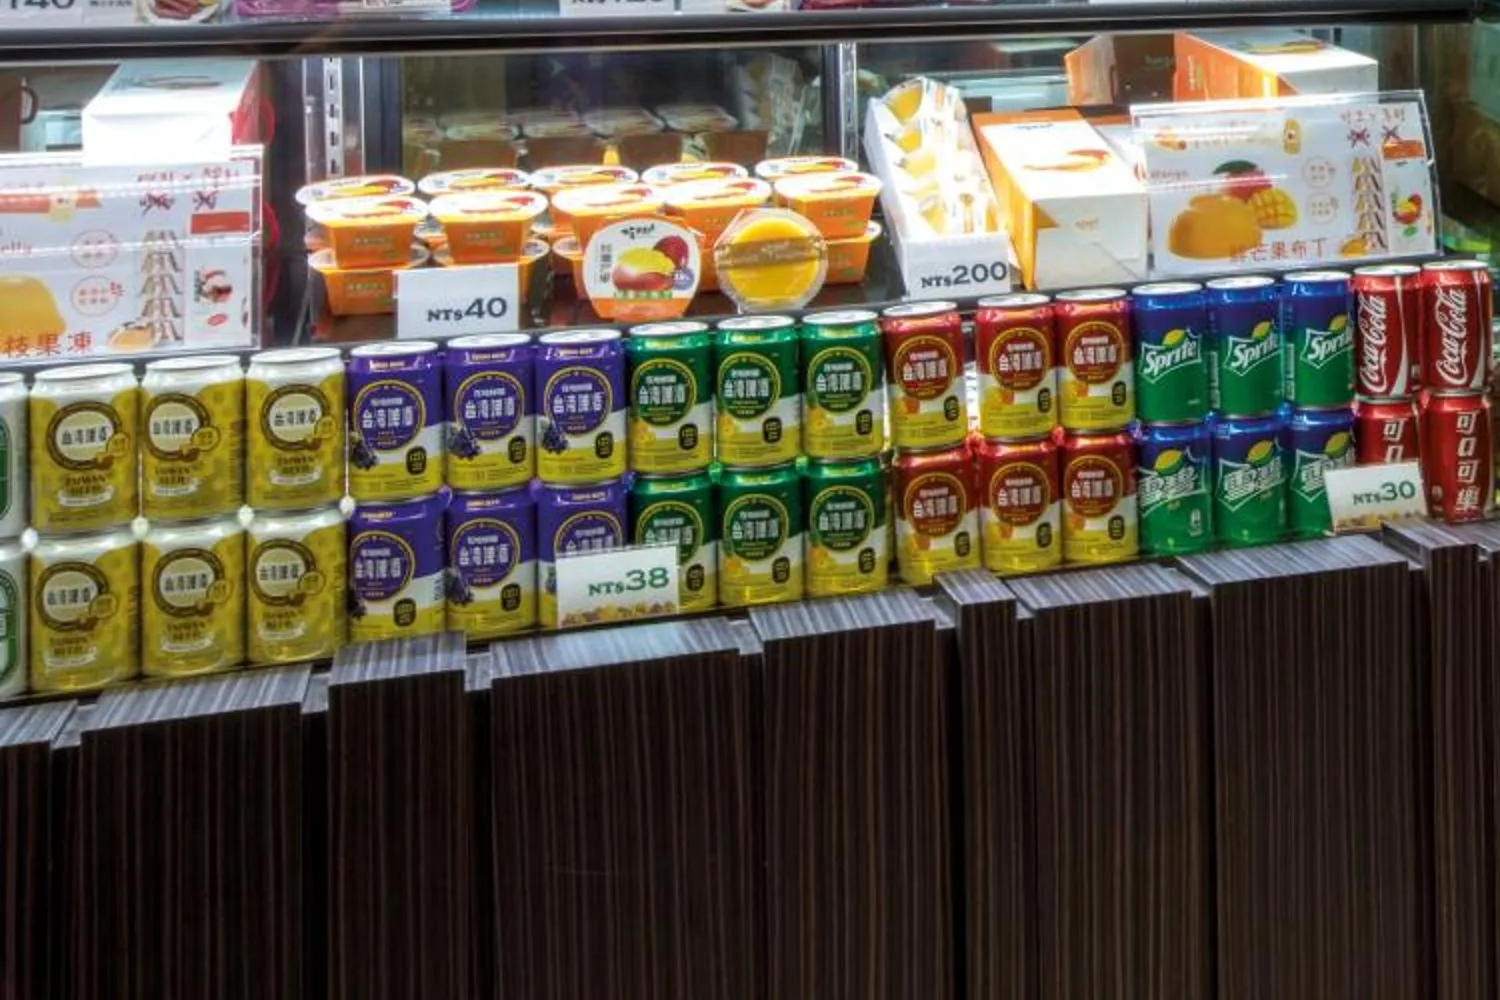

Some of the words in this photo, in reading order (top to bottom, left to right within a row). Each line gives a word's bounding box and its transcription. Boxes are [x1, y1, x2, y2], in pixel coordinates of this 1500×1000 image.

[920, 260, 1008, 289] NT$200
[426, 296, 508, 324] NT$40
[1357, 290, 1387, 393] Coca-Cola
[1434, 283, 1468, 386] Coca-Cola
[1142, 337, 1198, 376] Sprite
[1384, 417, 1408, 464] 可口
[1352, 479, 1418, 506] NT$30
[587, 566, 670, 597] NT$38
